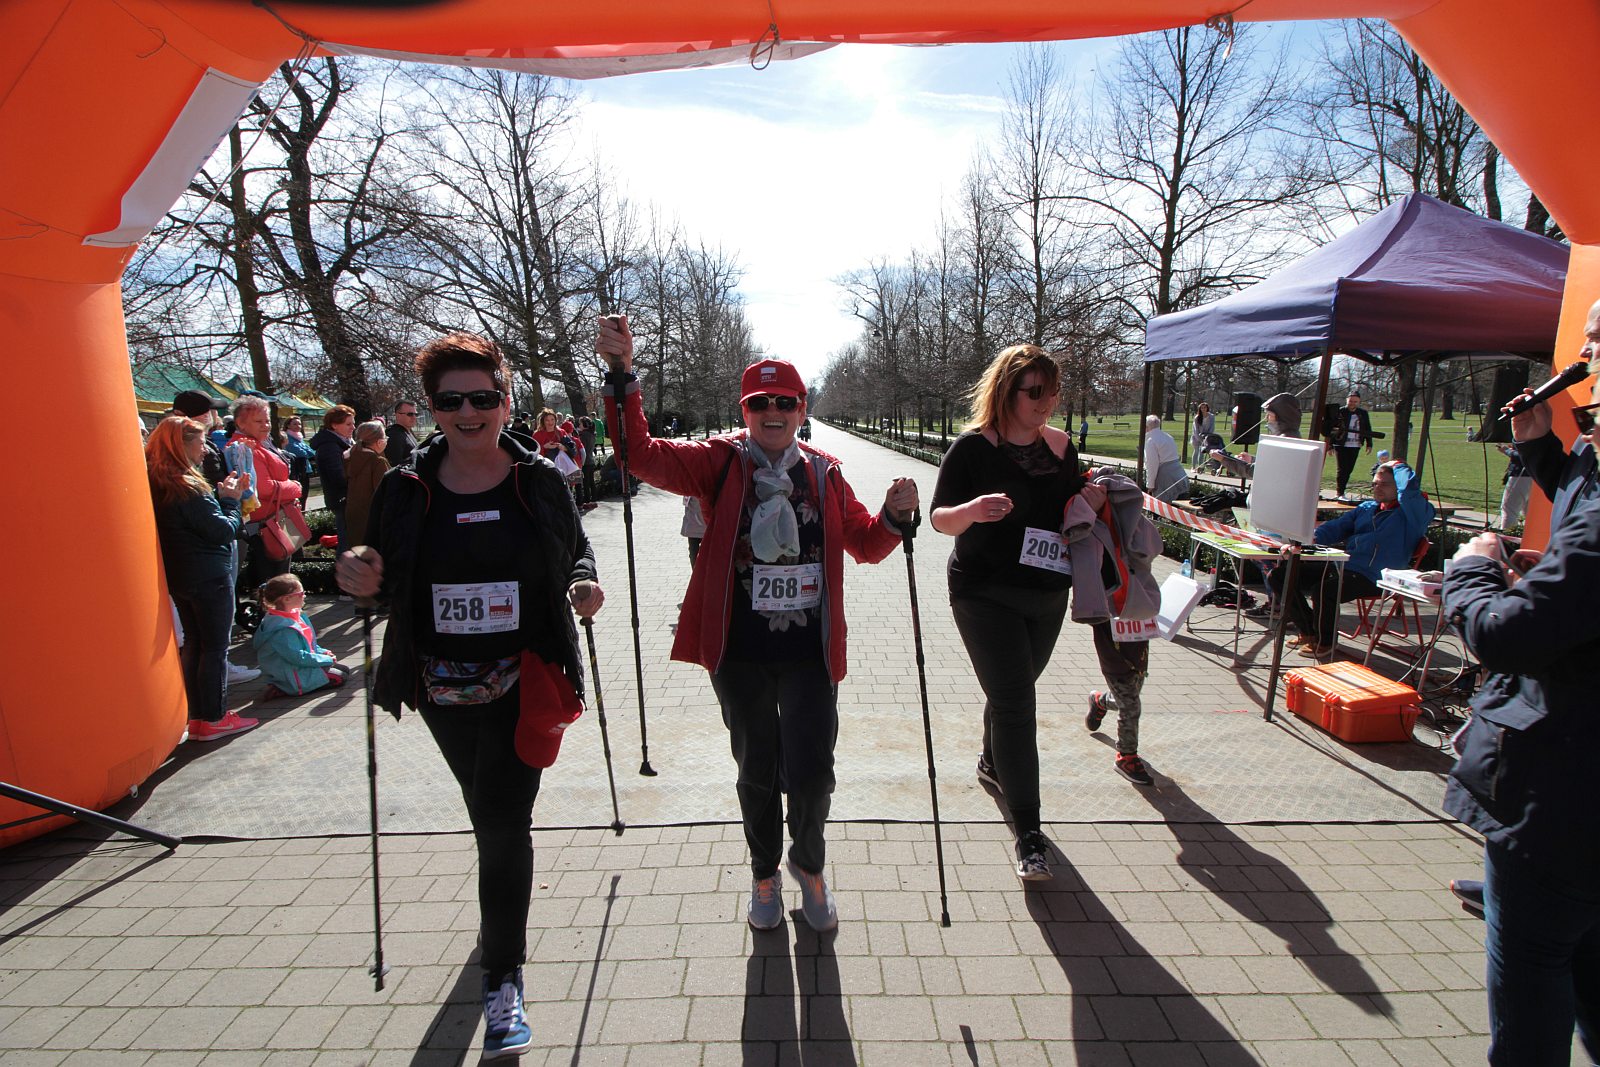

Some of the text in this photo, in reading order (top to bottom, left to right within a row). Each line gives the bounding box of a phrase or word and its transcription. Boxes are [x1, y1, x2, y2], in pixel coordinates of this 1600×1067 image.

[1026, 538, 1059, 560] 209
[758, 577, 797, 599] 268
[439, 597, 484, 621] 258
[1116, 620, 1142, 634] 010
